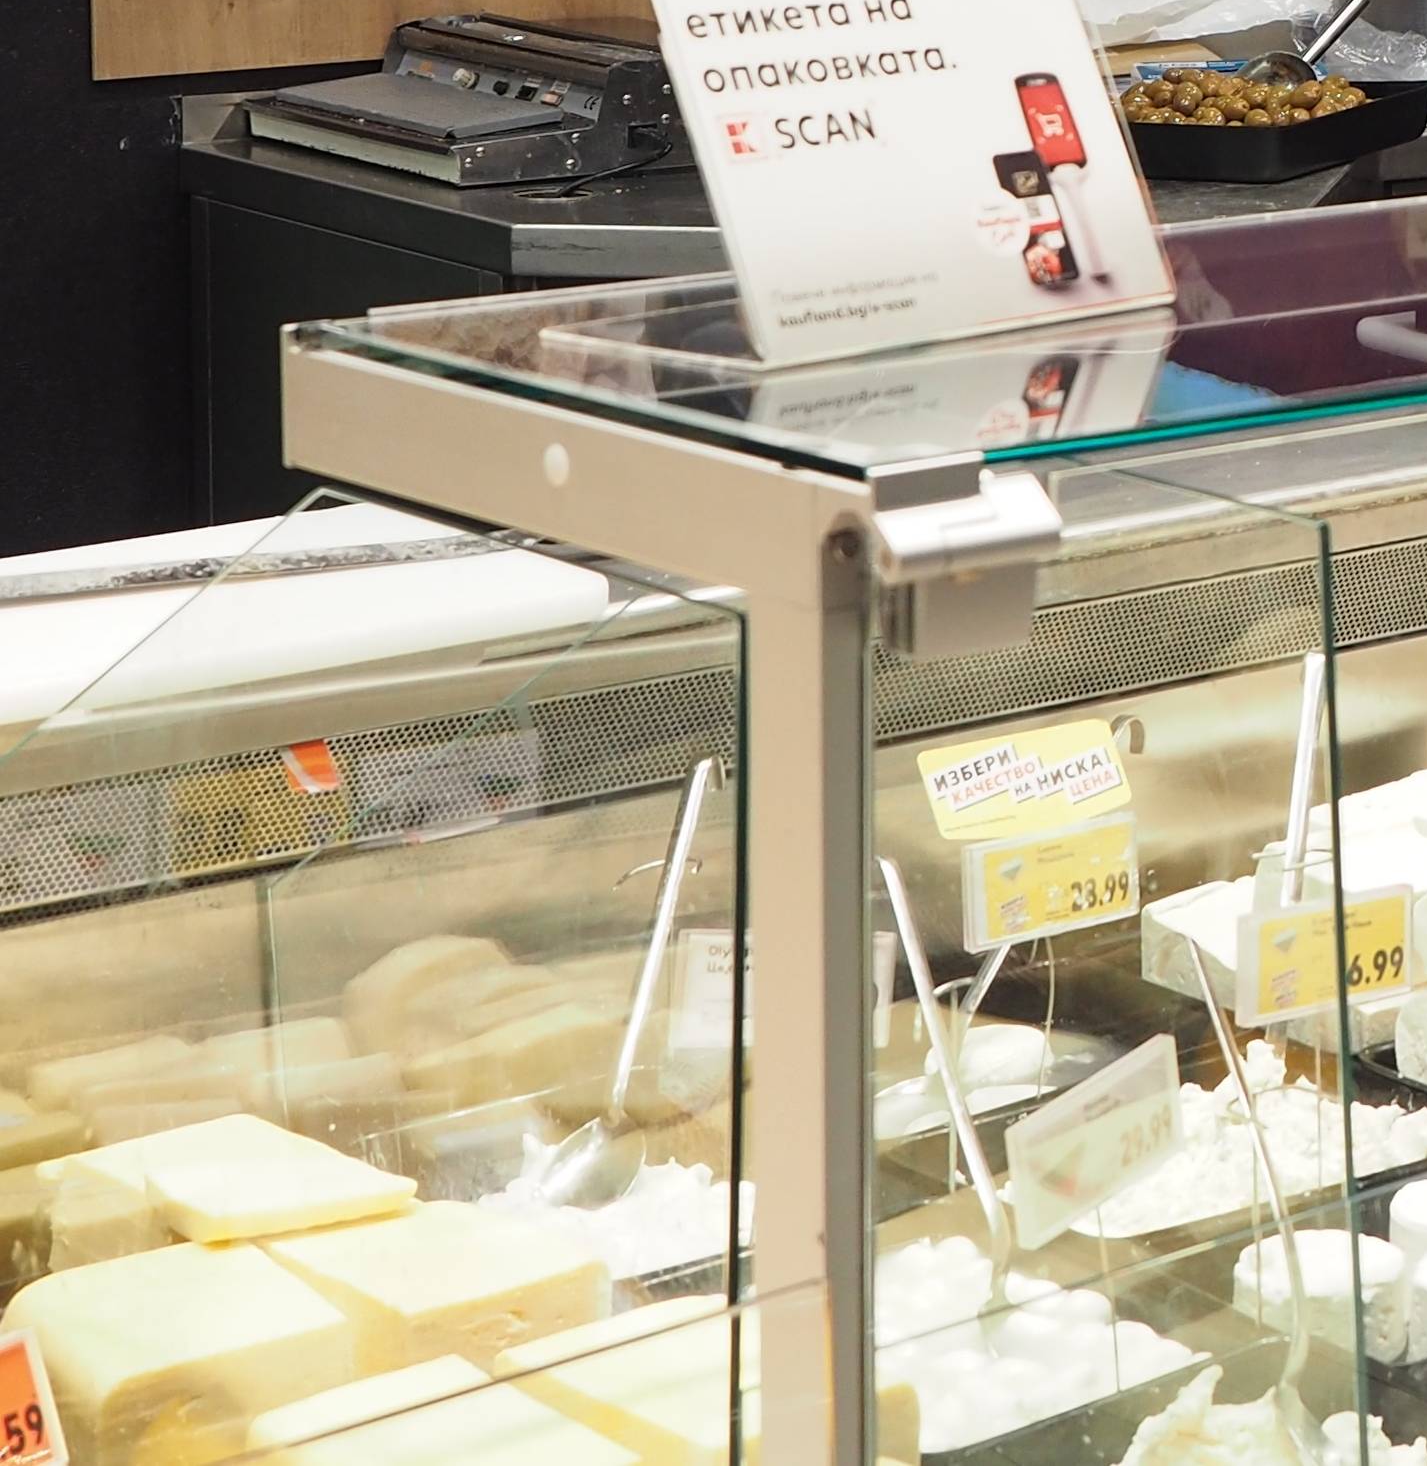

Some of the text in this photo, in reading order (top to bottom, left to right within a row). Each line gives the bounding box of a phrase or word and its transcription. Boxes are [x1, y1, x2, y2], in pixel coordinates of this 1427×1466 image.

[686, 0, 851, 40] етикета
[703, 39, 958, 95] опаковката.
[774, 111, 876, 150] SCAN
[934, 749, 1011, 792] ИЗБЕРИ
[951, 761, 1036, 805] КАЧЕСТВО
[1015, 753, 1103, 797] НА НИСКА
[1071, 770, 1115, 797] ЦЕНА
[1347, 946, 1404, 987] 6.99
